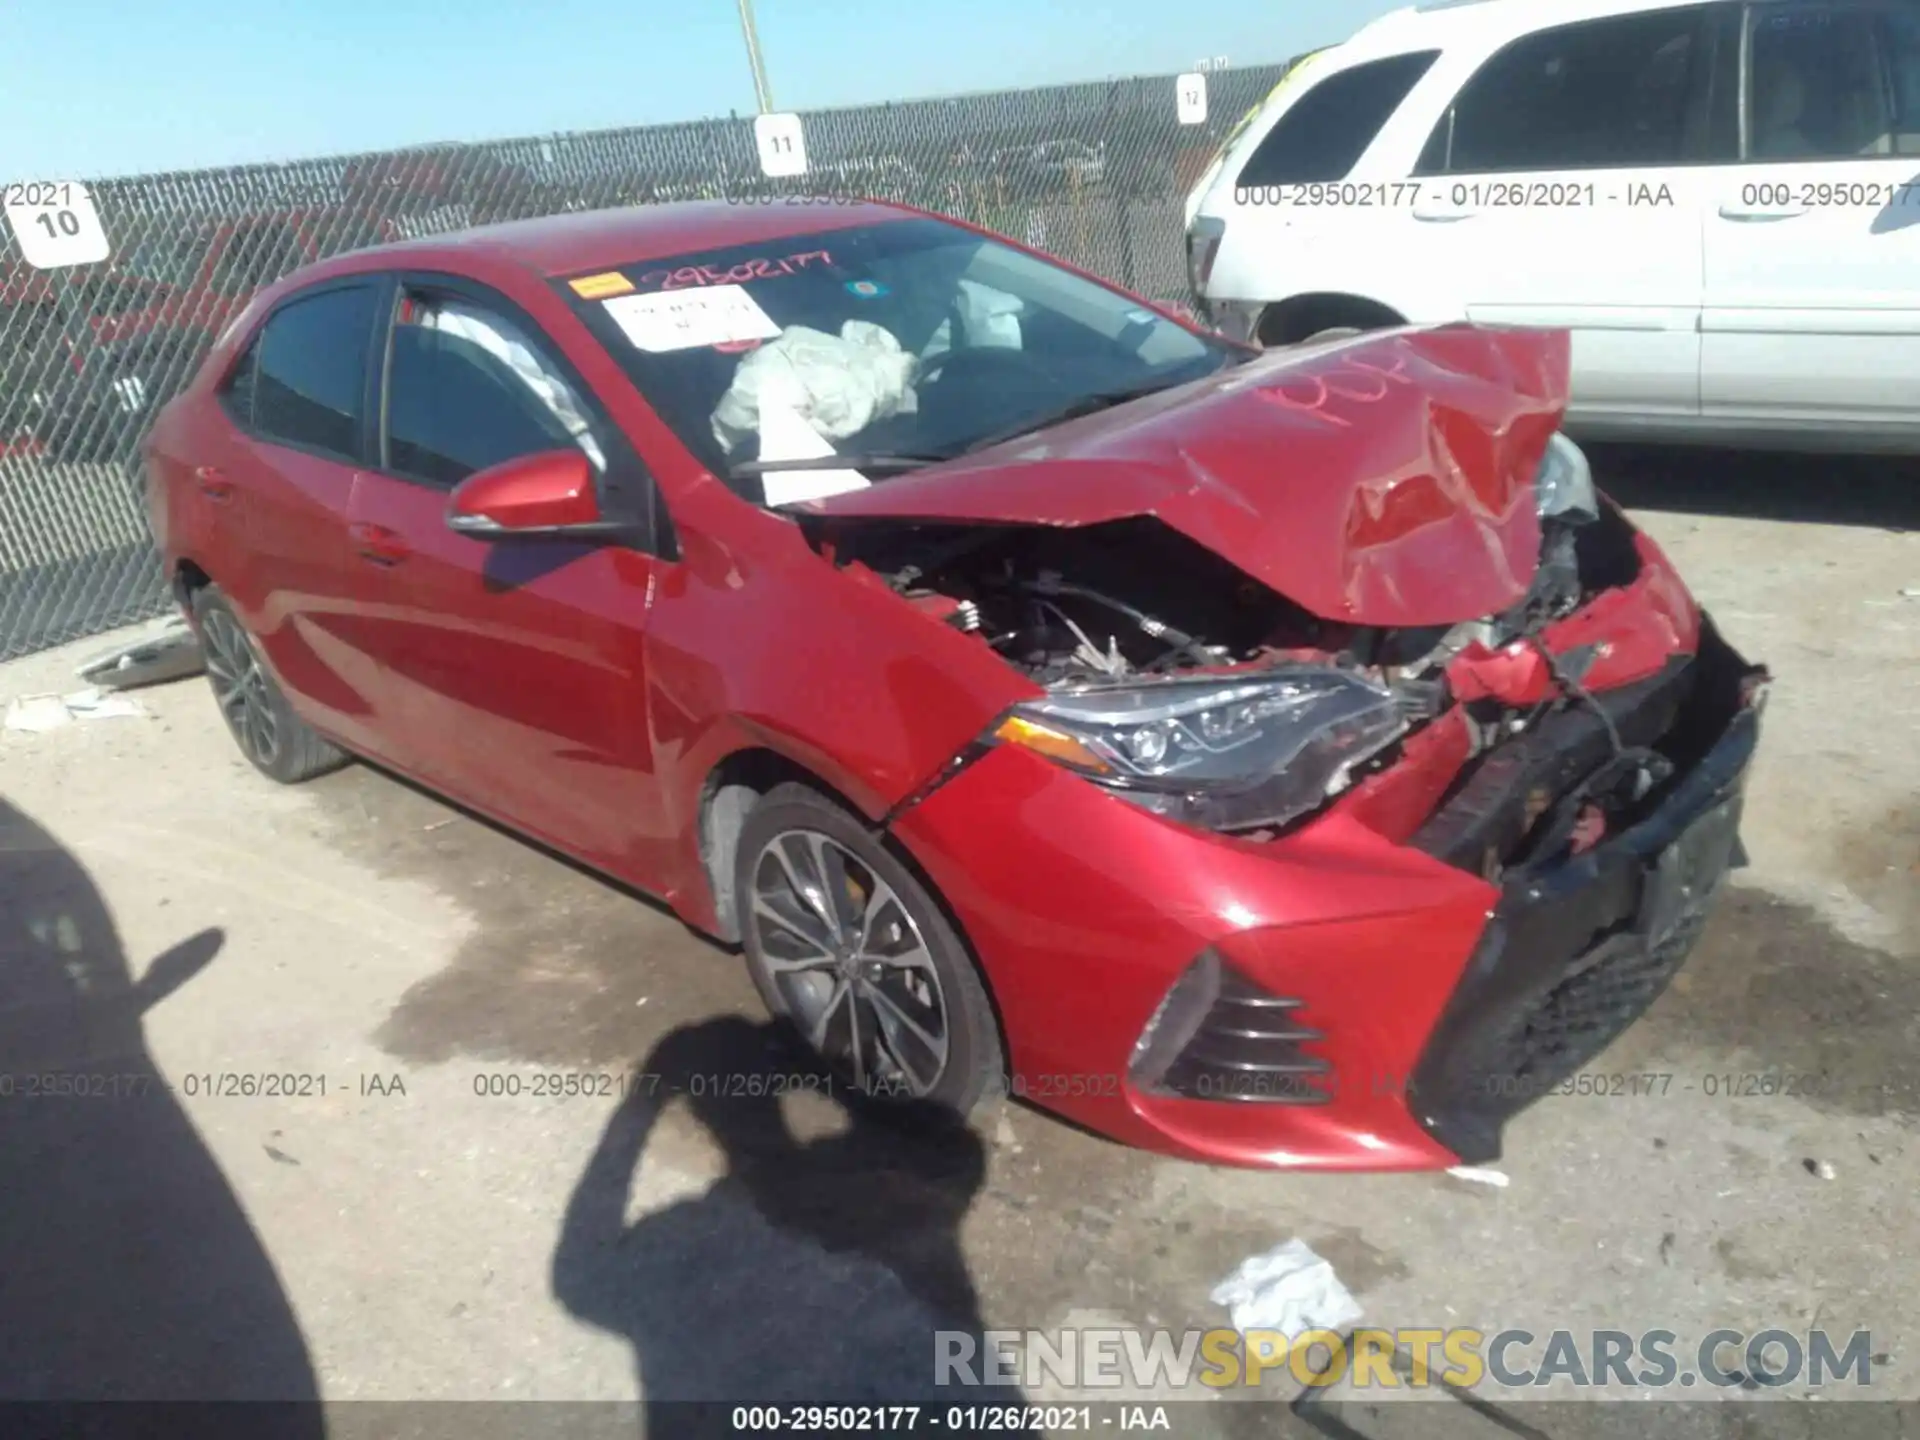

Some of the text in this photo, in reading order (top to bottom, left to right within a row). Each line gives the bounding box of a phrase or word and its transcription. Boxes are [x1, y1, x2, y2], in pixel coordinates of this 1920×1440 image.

[1185, 89, 1199, 106] 12
[771, 135, 792, 153] 11
[36, 210, 80, 239] 10
